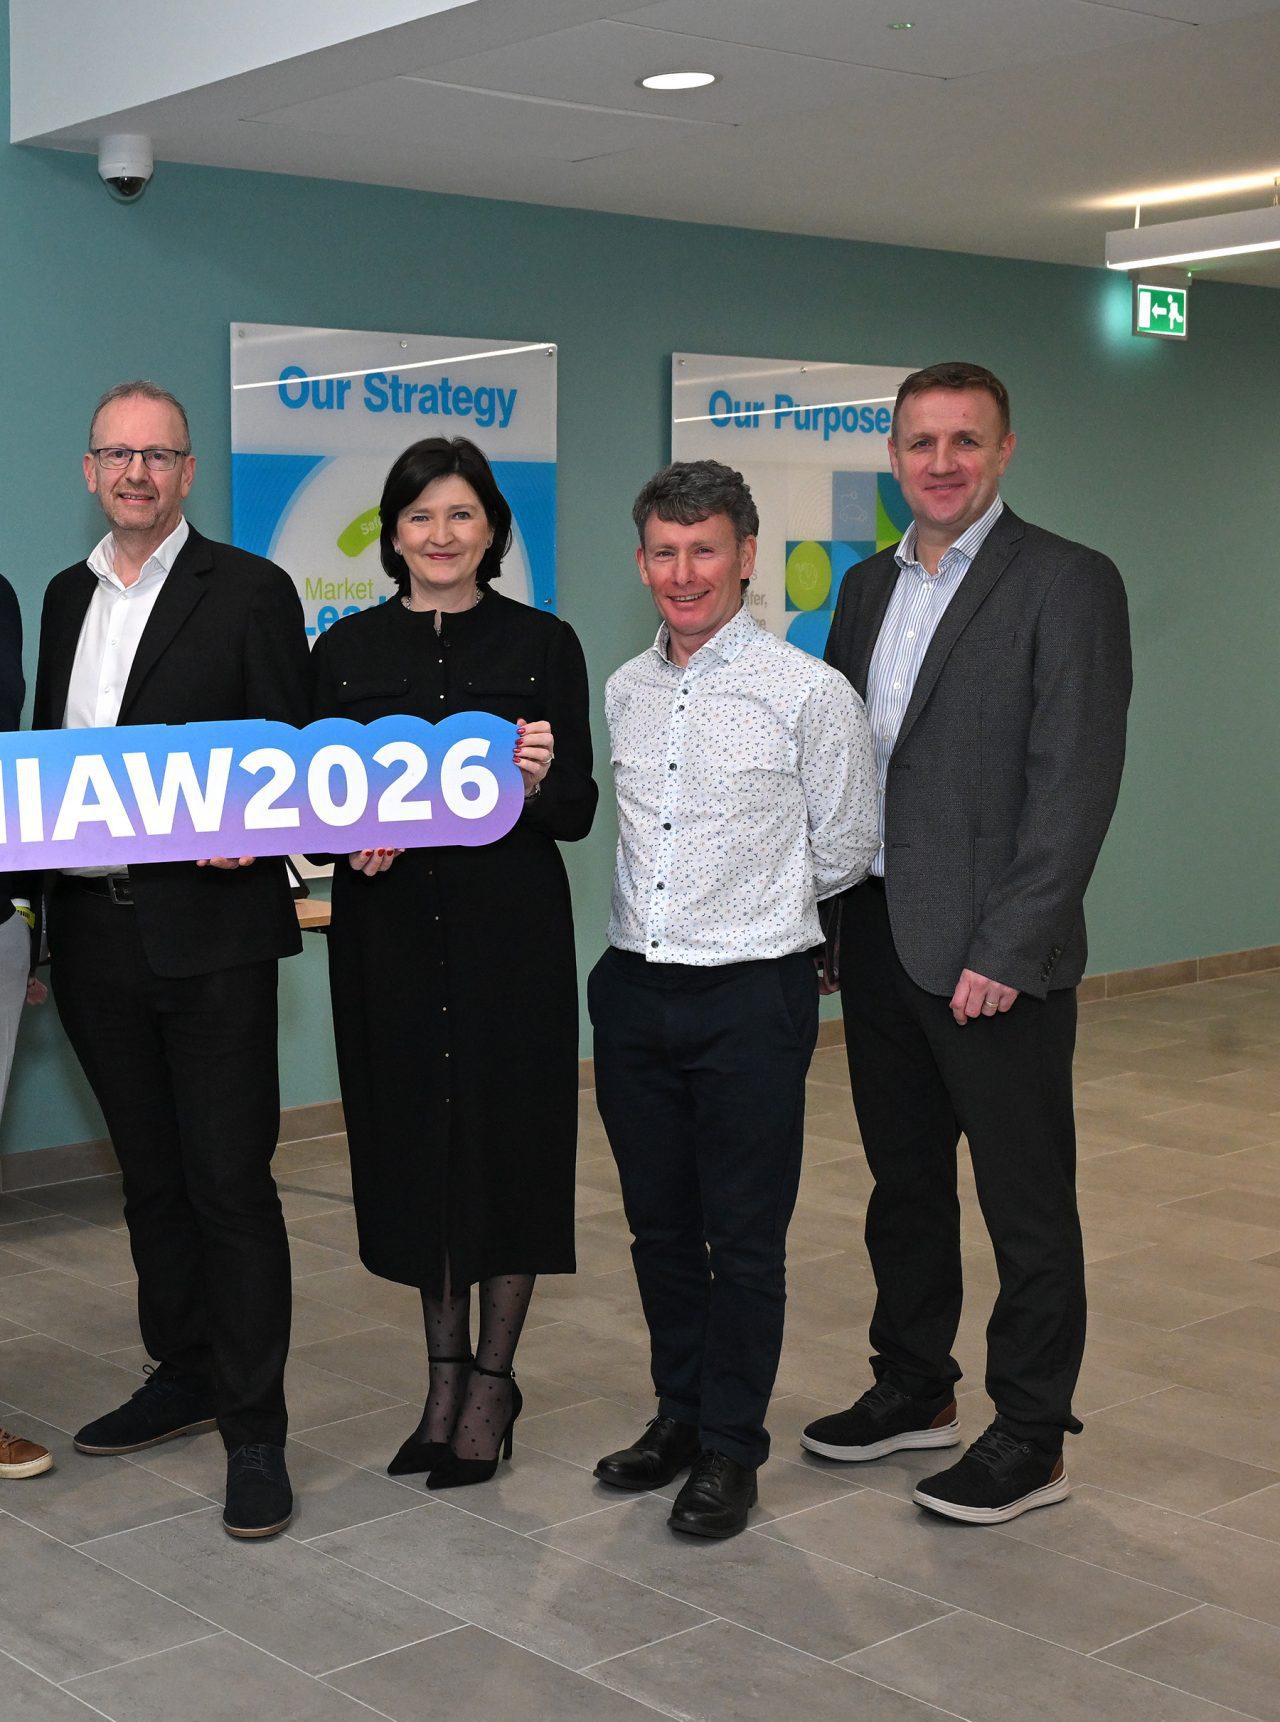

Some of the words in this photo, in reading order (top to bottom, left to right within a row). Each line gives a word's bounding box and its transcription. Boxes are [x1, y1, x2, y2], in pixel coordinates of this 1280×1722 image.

[277, 365, 352, 411] Our
[363, 371, 517, 429] Strategy
[708, 389, 765, 429] Our
[774, 393, 891, 442] Purpose
[305, 577, 375, 601] Market
